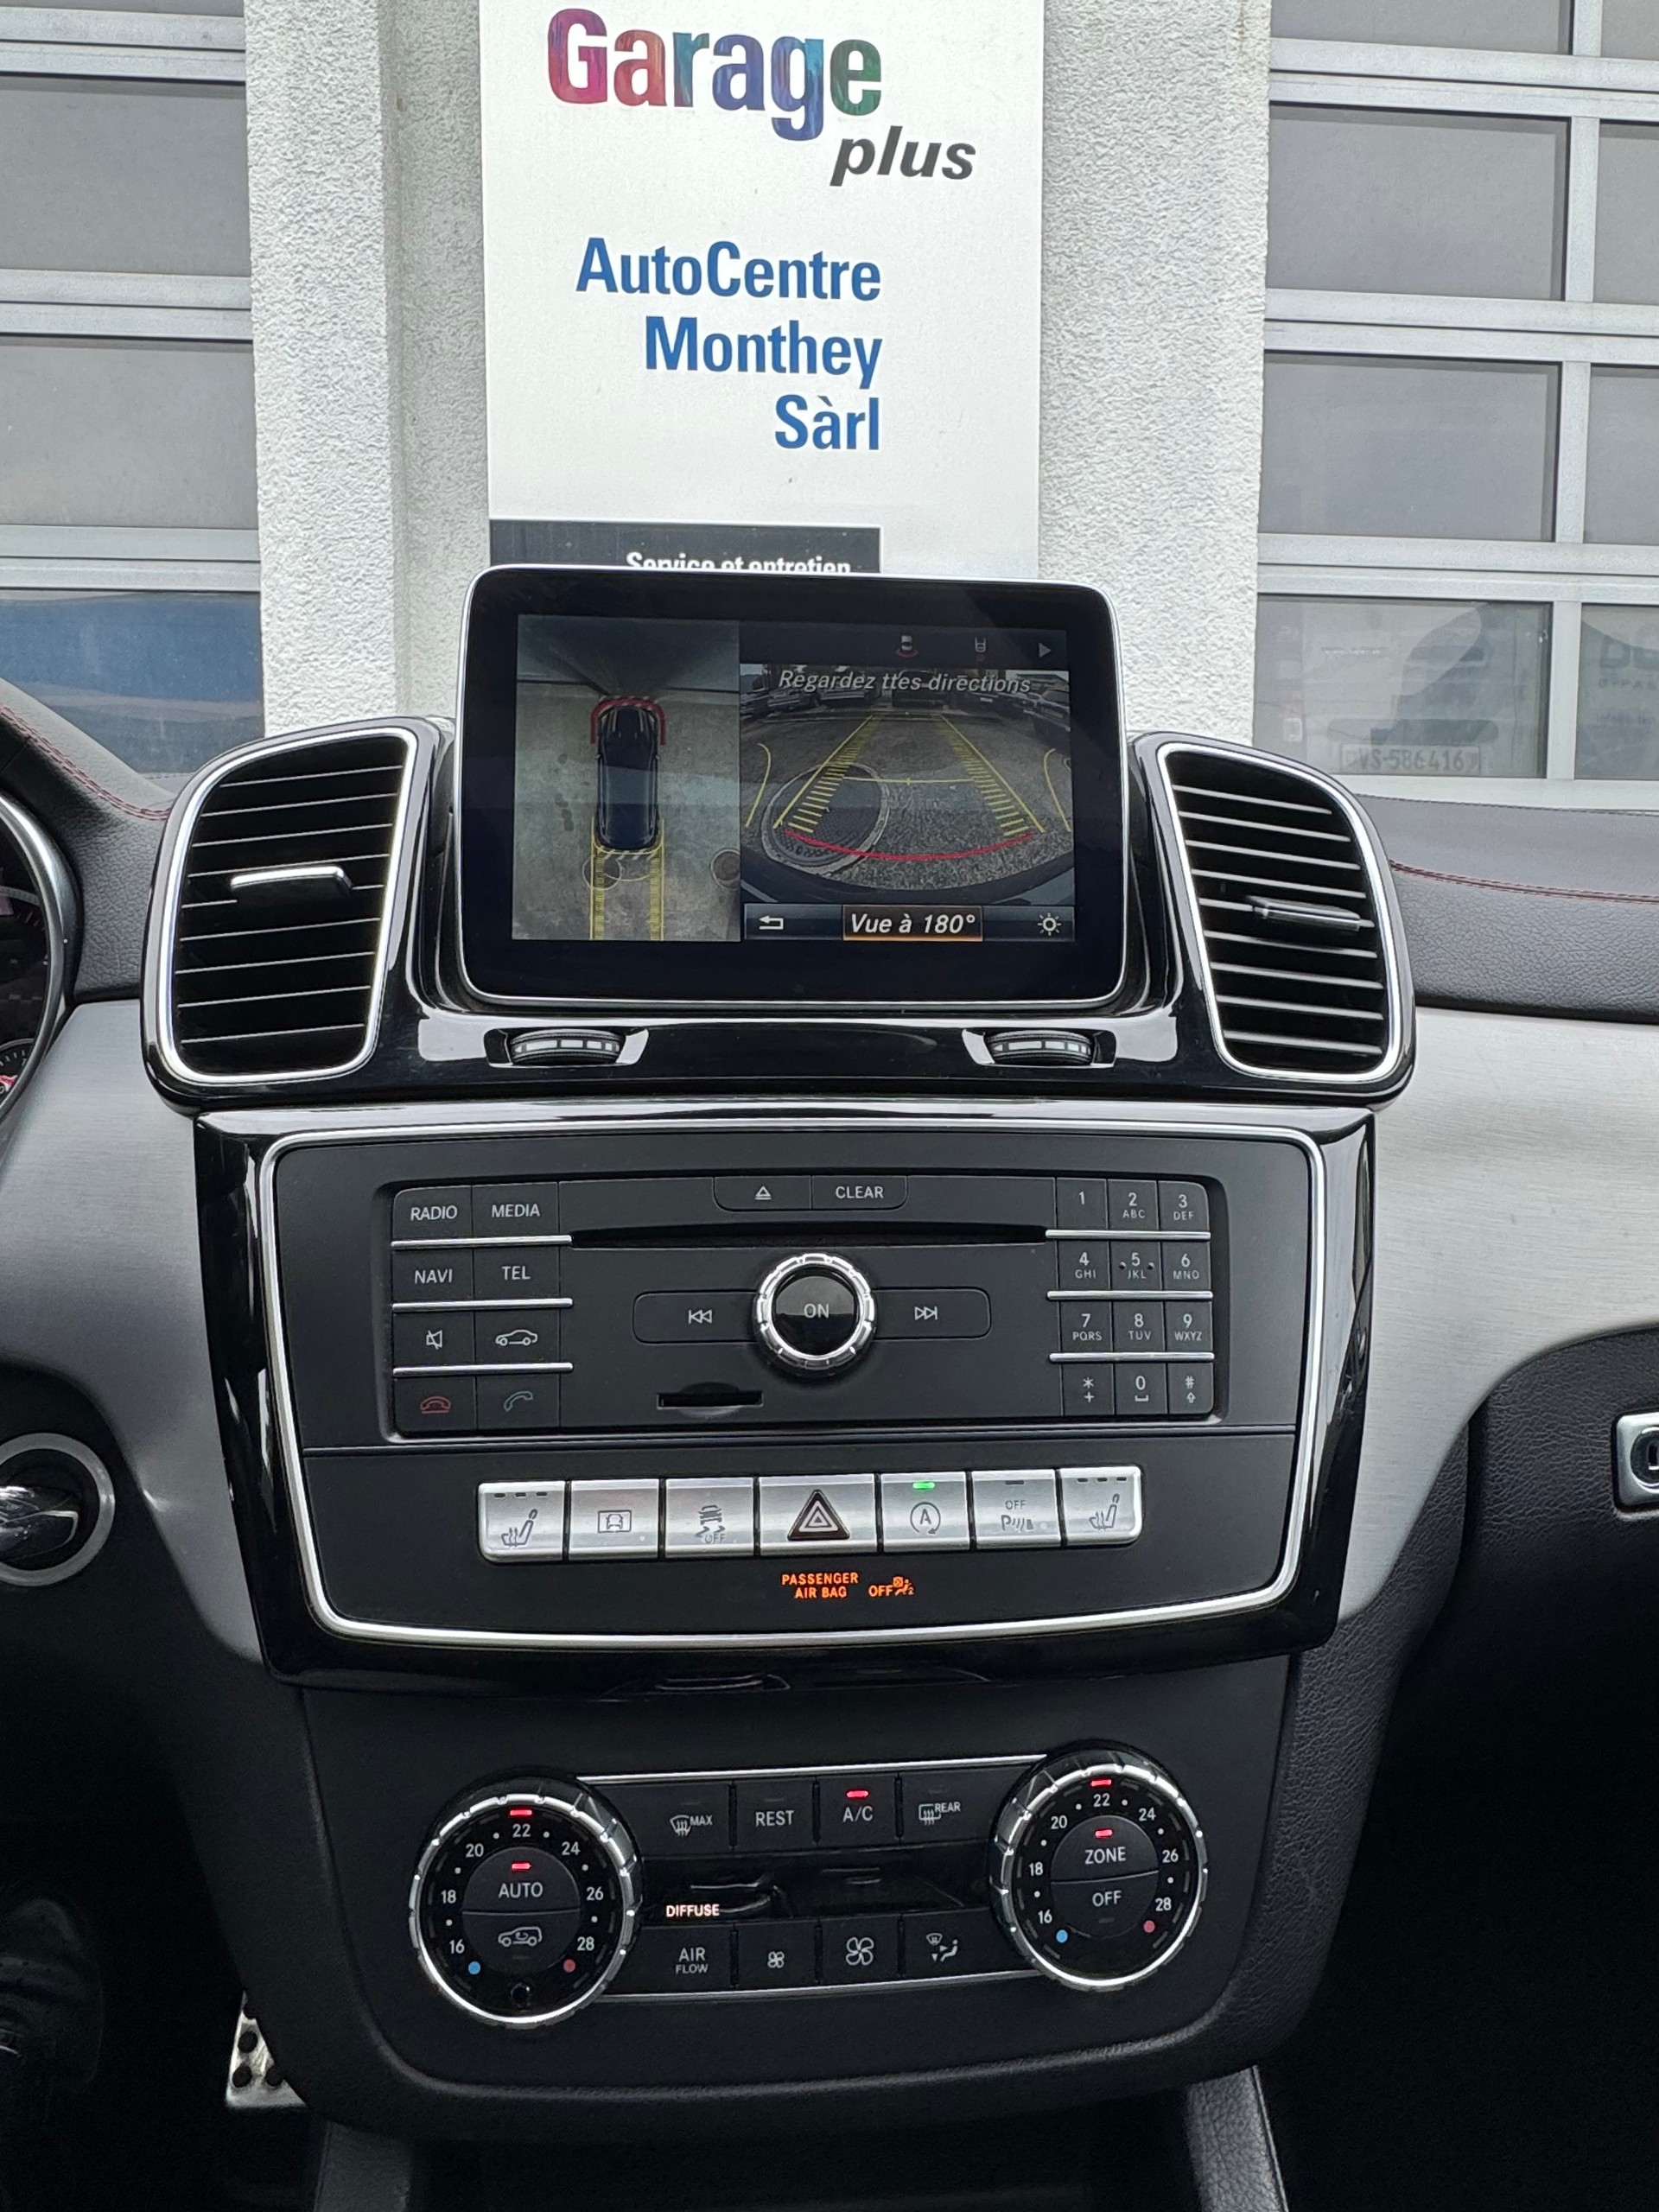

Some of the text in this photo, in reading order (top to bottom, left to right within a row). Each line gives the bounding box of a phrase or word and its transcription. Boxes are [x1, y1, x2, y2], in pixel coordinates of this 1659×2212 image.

[547, 8, 882, 142] Garage
[830, 125, 976, 187] plus
[575, 237, 881, 302] AutoCentre
[645, 315, 882, 390] Monthey
[775, 394, 880, 450] Sàrl
[779, 670, 875, 692] Regardez
[929, 673, 1031, 692] directions
[851, 913, 976, 934] Vue à 180°
[835, 1185, 884, 1199] CLEAR
[1079, 1191, 1085, 1205] 1
[1128, 1192, 1138, 1206] 2
[1179, 1194, 1188, 1208] 3
[410, 1205, 458, 1221] RADIO
[491, 1204, 541, 1218] MEDIA
[1123, 1210, 1146, 1219] ABC
[1173, 1211, 1194, 1221] DEF
[1079, 1252, 1090, 1266] 4
[1131, 1253, 1141, 1267] 5
[1180, 1253, 1191, 1268] 6
[414, 1268, 453, 1284] NAVI
[501, 1265, 531, 1281] TEL
[1075, 1269, 1096, 1279] GHI
[1128, 1269, 1147, 1279] JKL
[1173, 1270, 1199, 1280] MNO
[804, 1303, 830, 1319] ON
[1081, 1313, 1091, 1328] 7
[1135, 1313, 1144, 1327] 8
[1183, 1313, 1192, 1328] 9
[1072, 1332, 1103, 1341] PQRS
[1128, 1331, 1152, 1340] TUV
[1174, 1332, 1203, 1341] WXYZ
[1005, 1500, 1027, 1510] OFF
[920, 1509, 931, 1524] A
[705, 1533, 726, 1544] OFF
[781, 1572, 859, 1586] PASSENGER
[794, 1586, 847, 1599] AIR BAG
[868, 1585, 893, 1597] OFF
[934, 1802, 961, 1814] REAR
[1093, 1794, 1110, 1808] 22
[690, 1815, 713, 1827] MAX
[755, 1811, 794, 1827] REST
[842, 1806, 873, 1822] A/C
[1138, 1808, 1156, 1822] 24
[1051, 1815, 1068, 1829] 20
[512, 1824, 531, 1838] 22
[466, 1844, 484, 1858] 20
[562, 1842, 581, 1856] 24
[1084, 1847, 1127, 1865] ZONE
[1162, 1849, 1179, 1863] 26
[1029, 1862, 1043, 1876] 18
[441, 1890, 456, 1904] 18
[498, 1883, 543, 1898] AUTO
[587, 1887, 604, 1901] 26
[1091, 1890, 1122, 1907] OFF
[1154, 1897, 1172, 1912] 28
[665, 1904, 720, 1917] DIFFUSE
[1038, 1910, 1052, 1924] 16
[449, 1940, 465, 1955] 16
[577, 1936, 595, 1951] 28
[678, 1948, 706, 1961] AIR
[675, 1963, 709, 1974] FLOW
